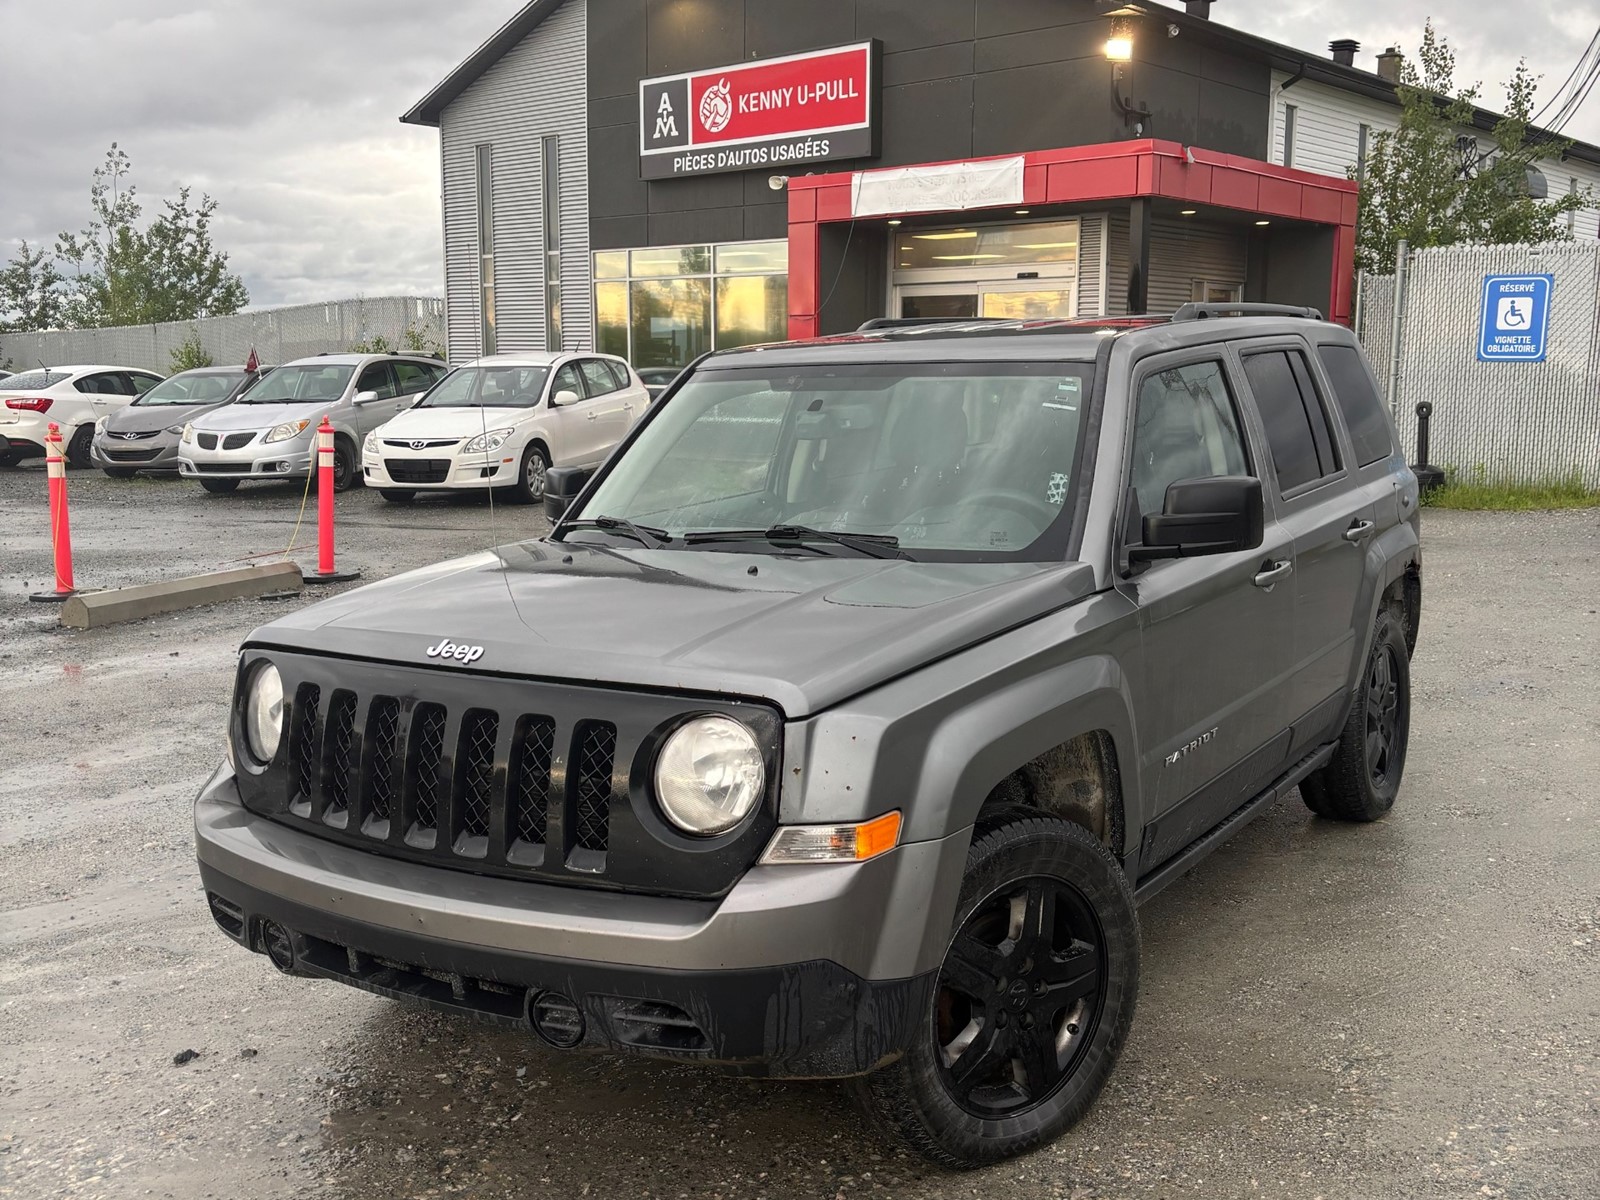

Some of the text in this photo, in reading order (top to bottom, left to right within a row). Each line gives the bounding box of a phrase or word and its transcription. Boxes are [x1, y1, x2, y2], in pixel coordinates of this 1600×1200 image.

[738, 77, 859, 114] KENNY U-PULL
[673, 137, 830, 172] PIÈCES D'AUTOS USAGÉES
[1499, 282, 1535, 293] RÉSERVÉ
[1487, 344, 1536, 353] OBLIGATOIRE
[1494, 335, 1532, 344] VIGNETTE
[426, 638, 485, 665] Jeep
[1164, 726, 1219, 768] PATRIOT
